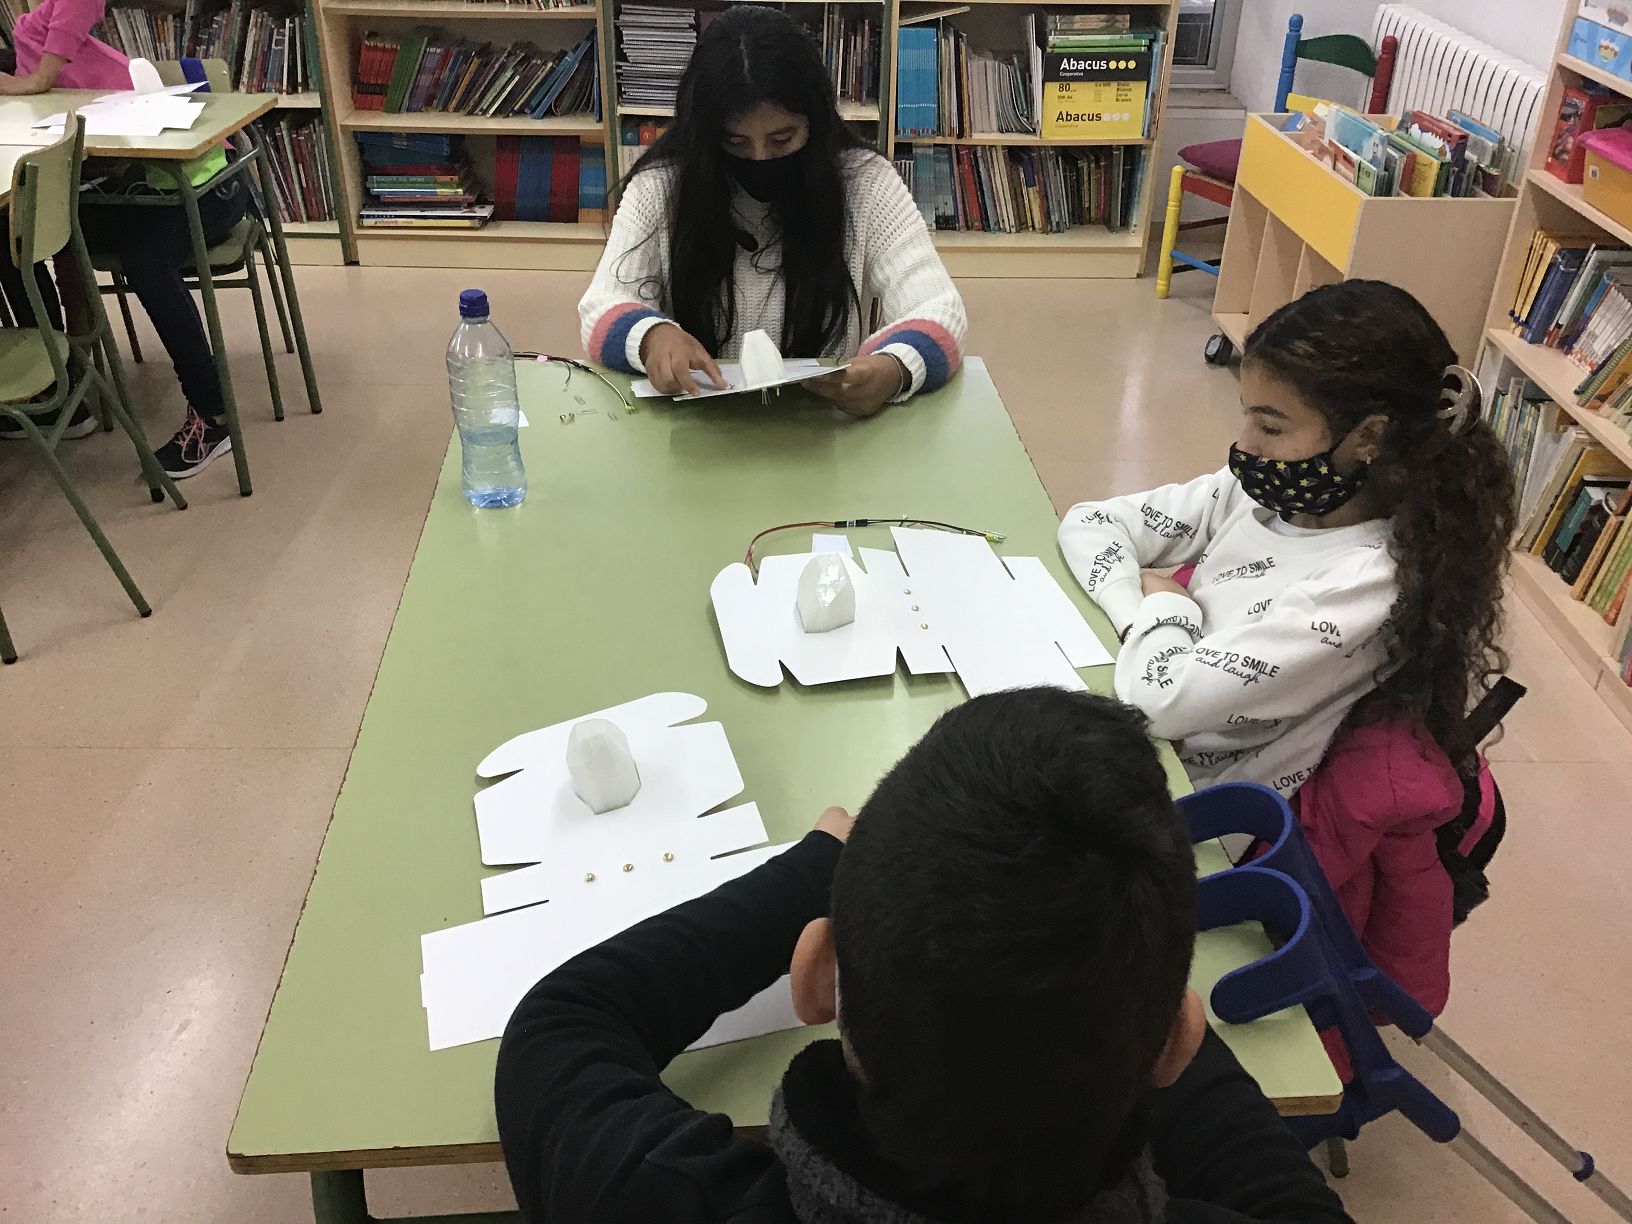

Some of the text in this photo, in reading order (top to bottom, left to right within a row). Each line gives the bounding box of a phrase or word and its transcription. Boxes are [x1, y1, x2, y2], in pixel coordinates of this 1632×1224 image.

[1060, 58, 1107, 70] Abacus
[1058, 83, 1071, 92] 80
[1056, 110, 1102, 122] Abacus
[1140, 502, 1163, 522] LOVE
[1161, 515, 1174, 529] TO
[1093, 554, 1106, 567] TO
[1235, 565, 1248, 577] TO
[1248, 557, 1276, 574] SMILE
[1088, 568, 1102, 592] LOVE
[1195, 656, 1262, 686] and laugh
[1222, 651, 1240, 664] TO
[1241, 655, 1281, 679] SMILE
[1272, 770, 1305, 791] LOVE
